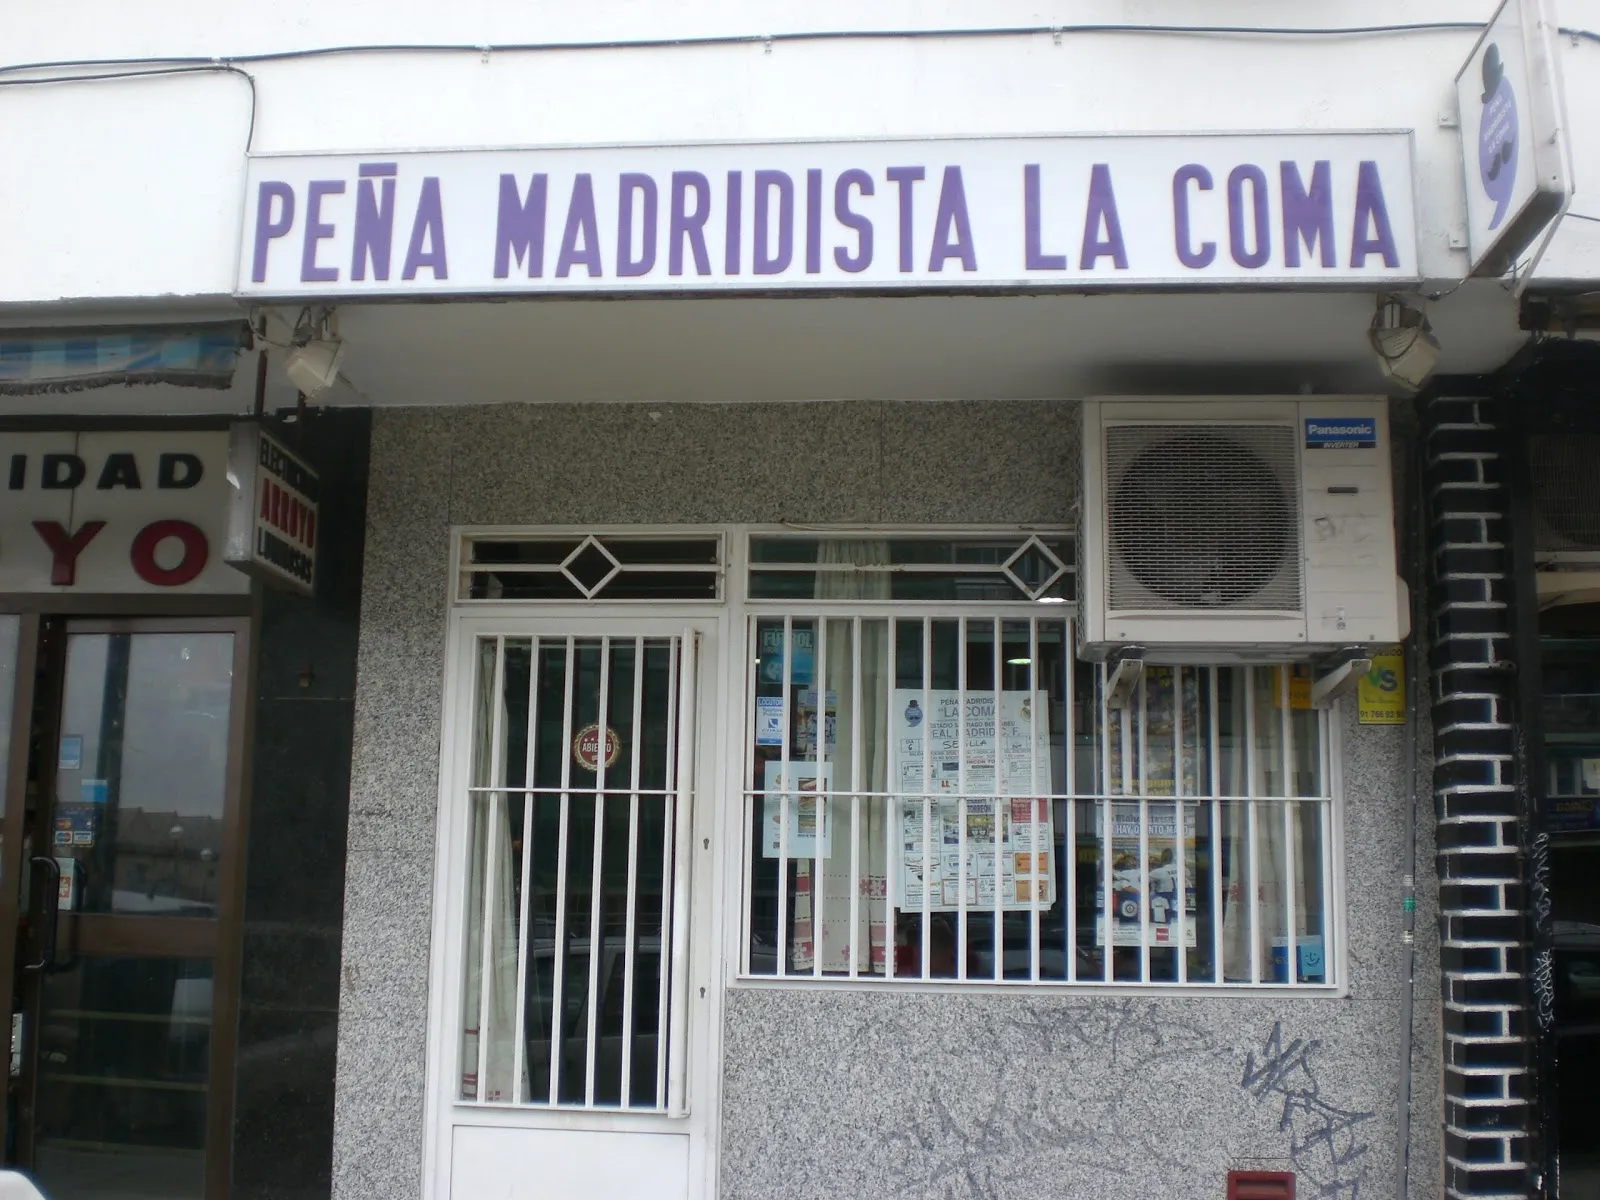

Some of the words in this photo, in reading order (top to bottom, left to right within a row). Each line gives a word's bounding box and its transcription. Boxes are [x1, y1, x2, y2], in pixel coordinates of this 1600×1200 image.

[251, 162, 448, 284] PEÑA
[493, 163, 978, 280] MADRIDISTA
[1023, 163, 1129, 271] LA
[1172, 160, 1400, 270] COMA
[1308, 424, 1372, 435] Panasonic
[1323, 441, 1360, 449] INVERTER
